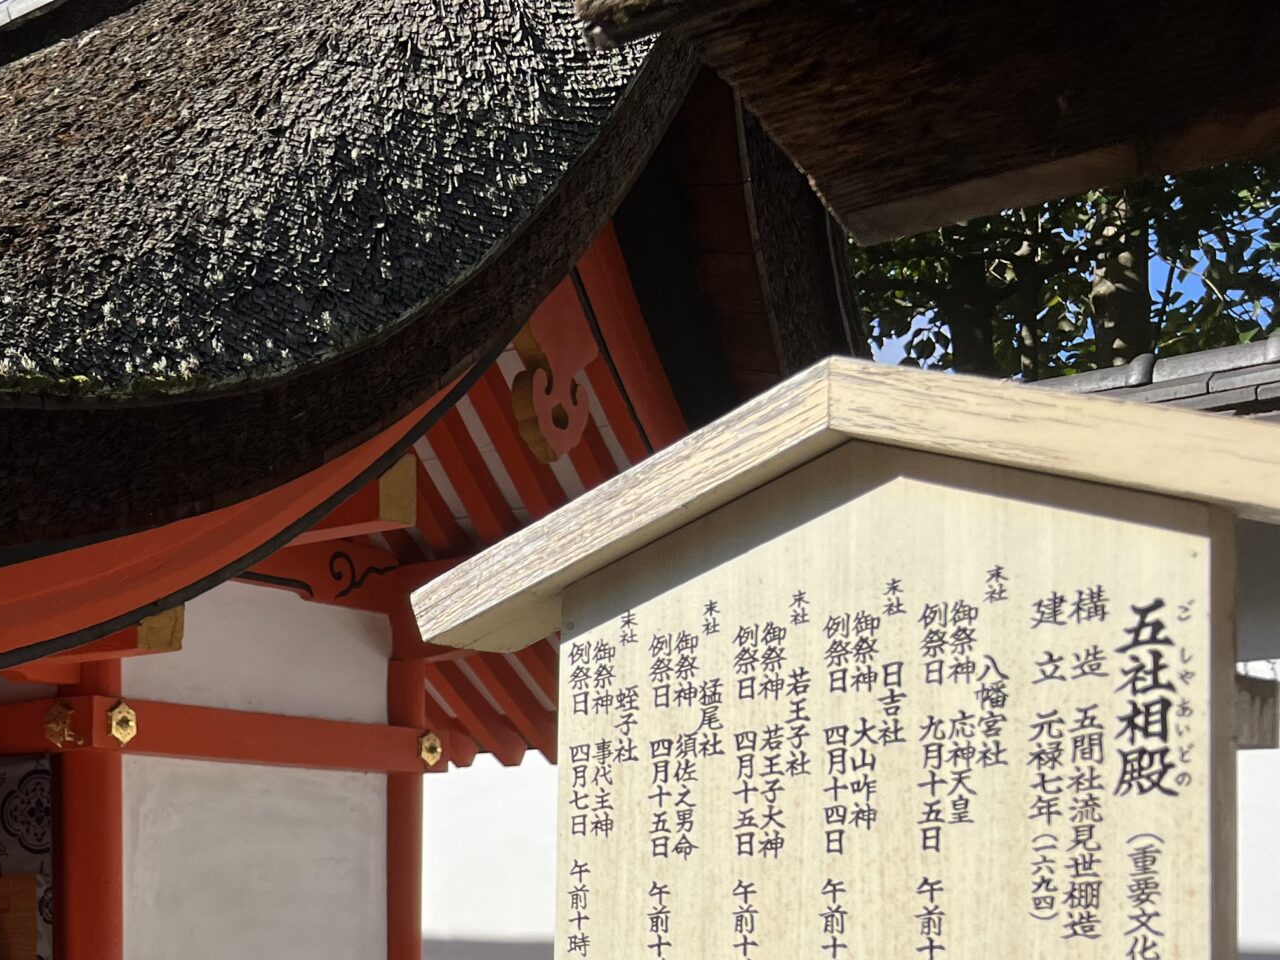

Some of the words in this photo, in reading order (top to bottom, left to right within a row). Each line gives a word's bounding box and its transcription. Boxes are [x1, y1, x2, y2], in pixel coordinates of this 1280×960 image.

[701, 599, 721, 636] 末社
[788, 589, 811, 626] 末社
[882, 577, 907, 617] 末社
[983, 564, 1009, 604] 末社
[619, 609, 639, 647] 末社
[648, 632, 675, 709] 例祭日
[672, 629, 700, 708] 御祭神
[731, 622, 760, 701] 例祭日
[757, 620, 788, 702] 御祭神
[822, 612, 854, 694] 例祭日
[849, 609, 882, 693] 御祭神
[917, 601, 949, 687] 例祭日
[948, 599, 979, 685] 御祭神
[567, 640, 593, 716] 例祭日
[591, 638, 617, 716] 御祭神
[697, 677, 726, 760] 猛尾社
[876, 660, 908, 748] 日吉社
[973, 654, 1011, 769] 八幡宮社
[1112, 597, 1180, 798] 五社相殿
[612, 684, 640, 764] 蛭子社
[784, 665, 812, 778] 若王子社
[568, 743, 591, 837] 四月七日
[590, 737, 615, 839] 事代主神
[647, 738, 675, 859] 四月十五日
[731, 730, 760, 857] 四月十五日
[757, 723, 787, 860] 若王子大神
[822, 724, 850, 856] 四月十四日
[847, 716, 880, 831] 大山咋神
[916, 714, 949, 854] 九月十五日
[943, 709, 978, 825] 応神天皇
[1060, 703, 1106, 940] 五間社流見世棚造
[566, 858, 591, 958] 午前十時
